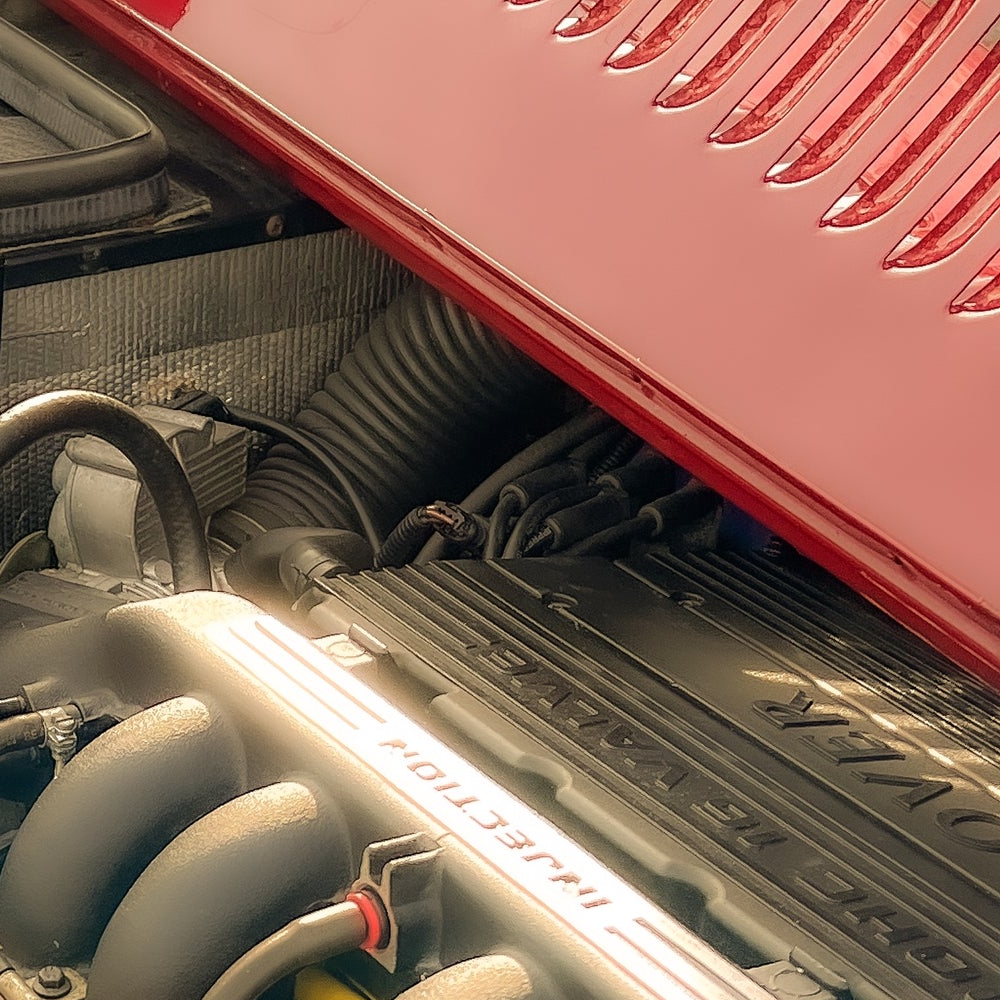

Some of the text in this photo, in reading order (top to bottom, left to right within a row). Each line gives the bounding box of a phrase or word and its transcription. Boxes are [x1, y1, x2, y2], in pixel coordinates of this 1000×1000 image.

[476, 649, 690, 792] VALVE
[378, 738, 613, 909] INJECTION
[689, 799, 789, 851] 16
